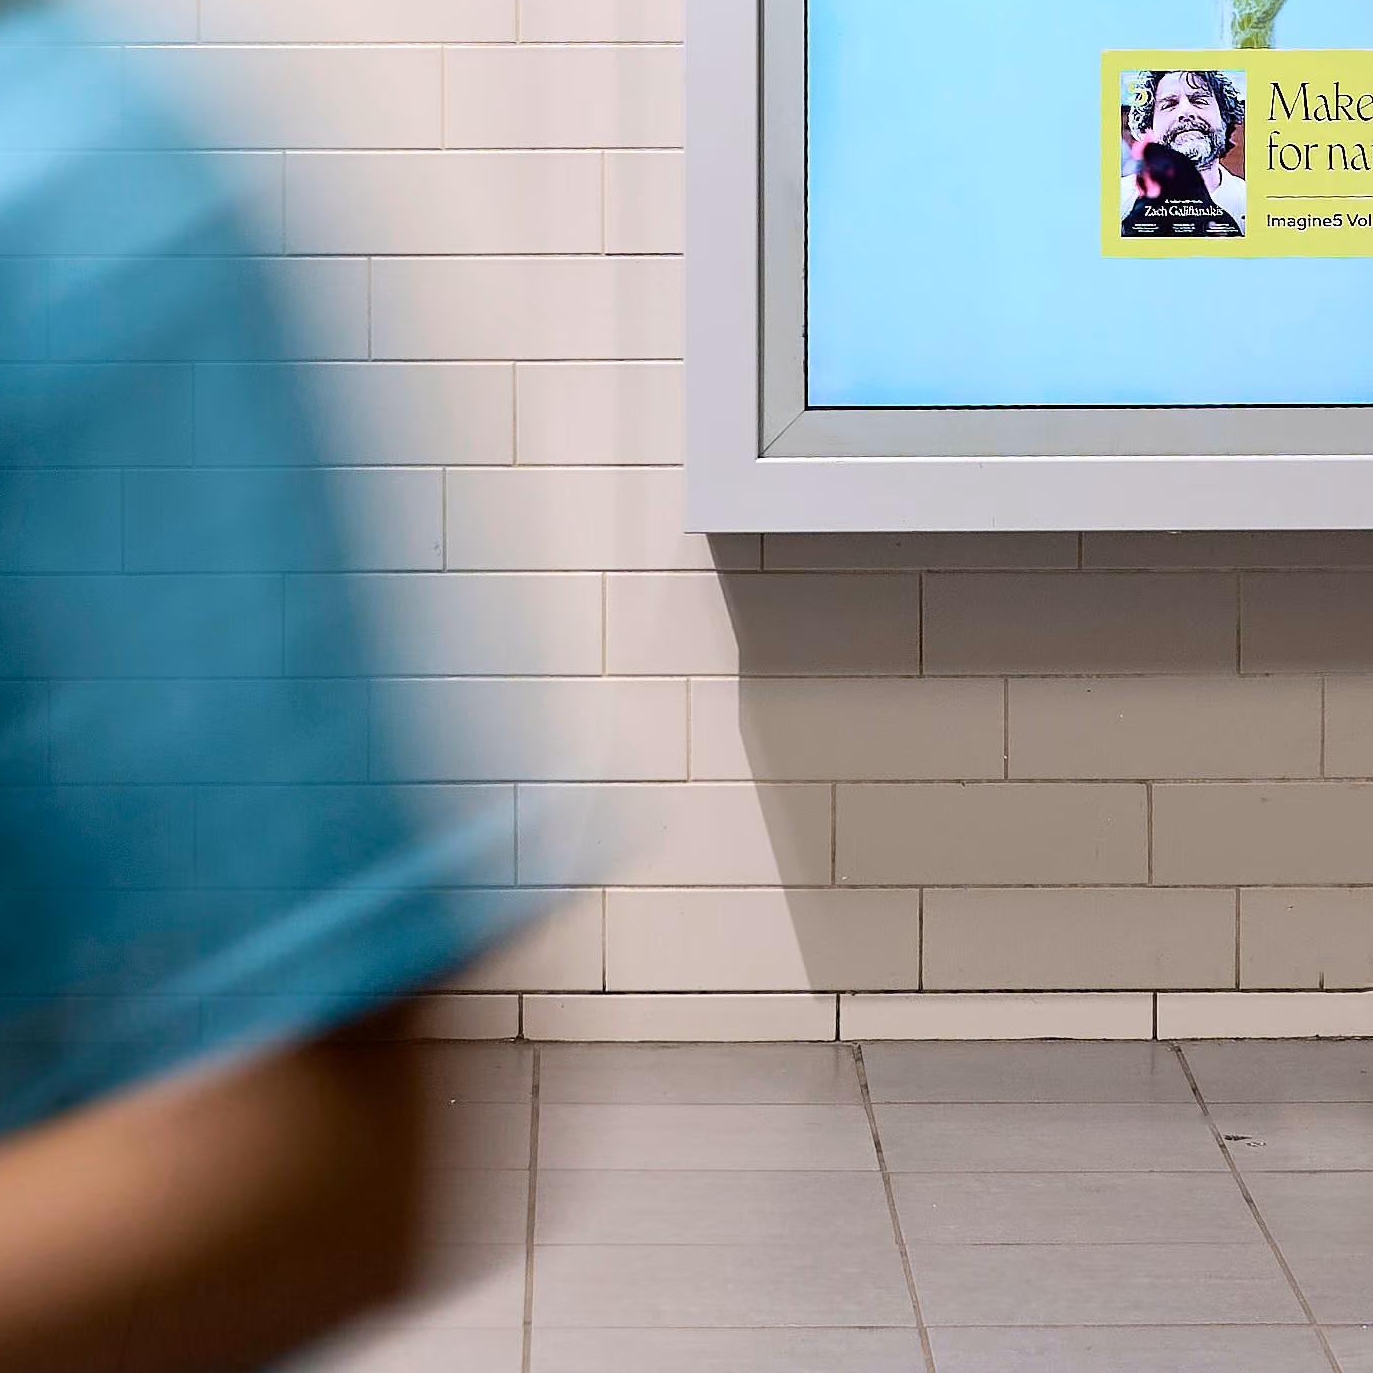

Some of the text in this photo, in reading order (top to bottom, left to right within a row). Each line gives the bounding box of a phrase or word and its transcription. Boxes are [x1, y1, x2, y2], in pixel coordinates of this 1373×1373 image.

[1266, 130, 1318, 172] for
[1144, 205, 1168, 217] Zach
[1266, 213, 1343, 231] Imagine5
